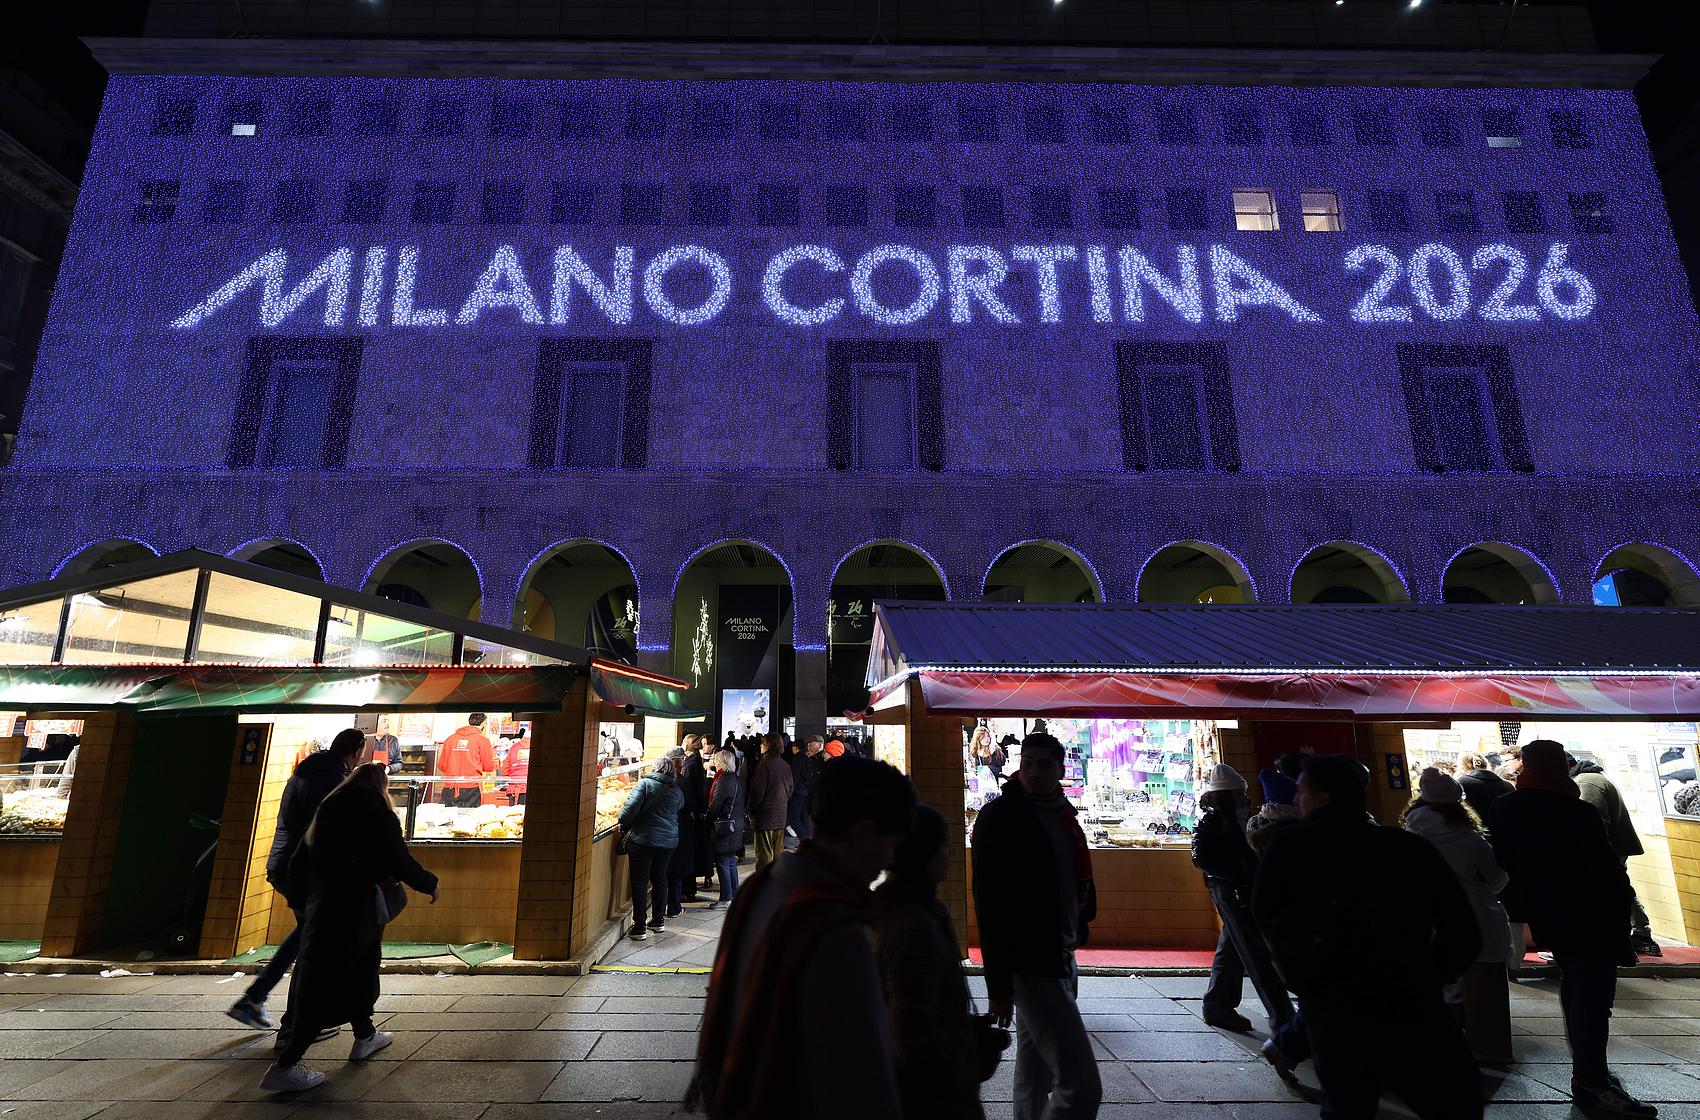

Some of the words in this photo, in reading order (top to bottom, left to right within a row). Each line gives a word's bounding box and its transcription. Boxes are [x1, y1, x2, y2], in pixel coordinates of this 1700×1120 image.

[169, 243, 733, 328] MILANO
[761, 242, 1324, 328] CORTINA
[1345, 241, 1597, 324] 2026
[724, 617, 762, 625] MILANO
[737, 632, 756, 640] 2026
